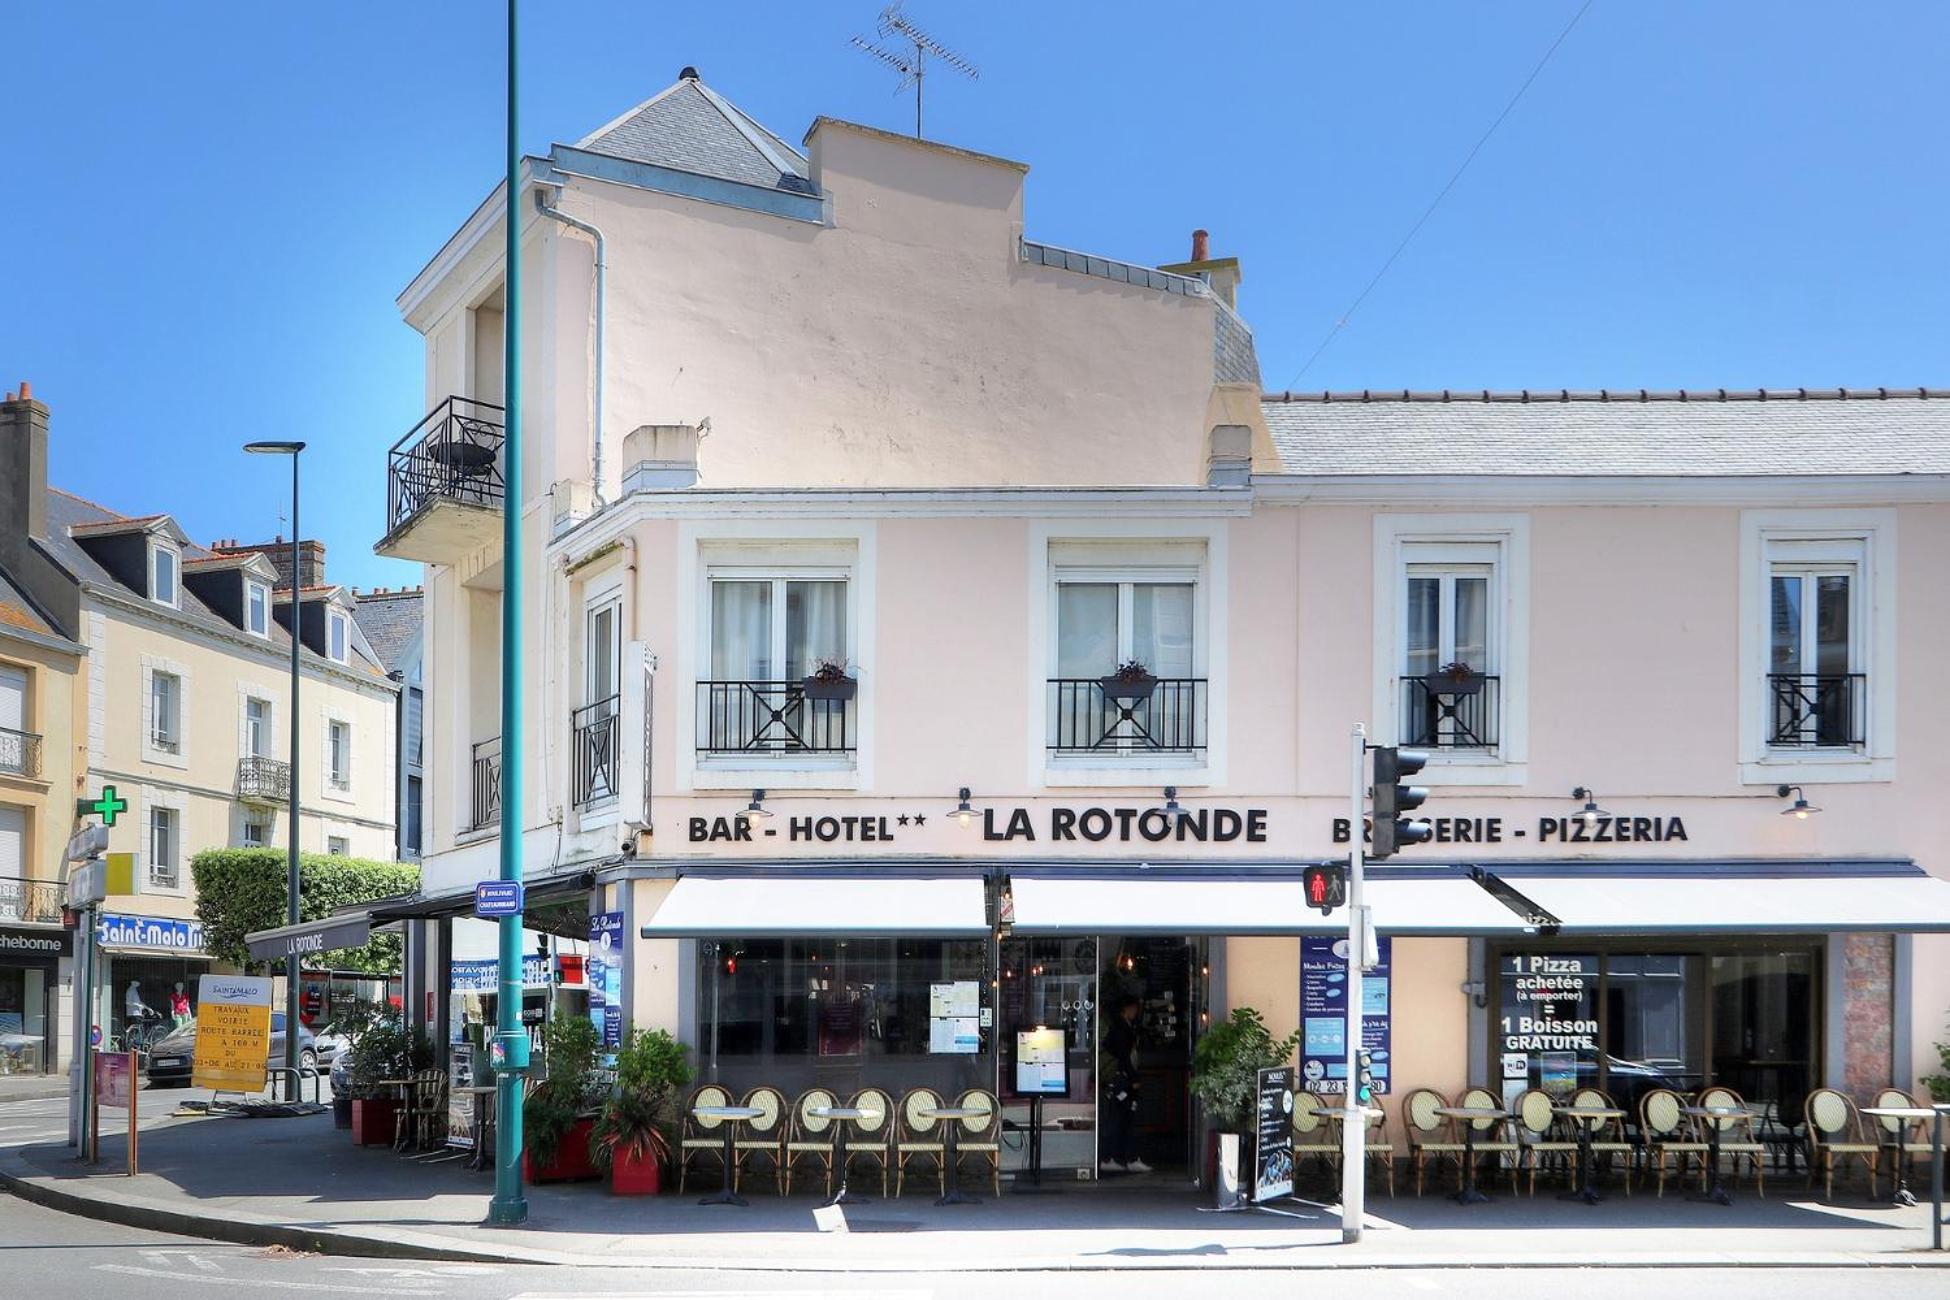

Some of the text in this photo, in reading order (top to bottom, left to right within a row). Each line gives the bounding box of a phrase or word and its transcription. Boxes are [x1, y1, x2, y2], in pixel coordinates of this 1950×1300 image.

[689, 817, 752, 842] BAR
[790, 816, 894, 842] HOTEL
[983, 808, 1268, 842] LA ROTONDE
[1333, 818, 1502, 843] BRSERIE
[1539, 817, 1688, 842] PIZZERIA
[101, 921, 186, 947] Saint-Malo
[286, 934, 323, 954] LA ROTONDE
[1512, 956, 1581, 973] 1 Pizza
[1516, 974, 1584, 989] achetée
[1516, 991, 1583, 1002] (à emporter)
[214, 1005, 249, 1014] TRAVAUX
[201, 1026, 226, 1034] ROUTE
[1501, 1016, 1598, 1033] 1 Boisson
[1506, 1035, 1594, 1050] GRATUITE
[1309, 1080, 1321, 1093] 02
